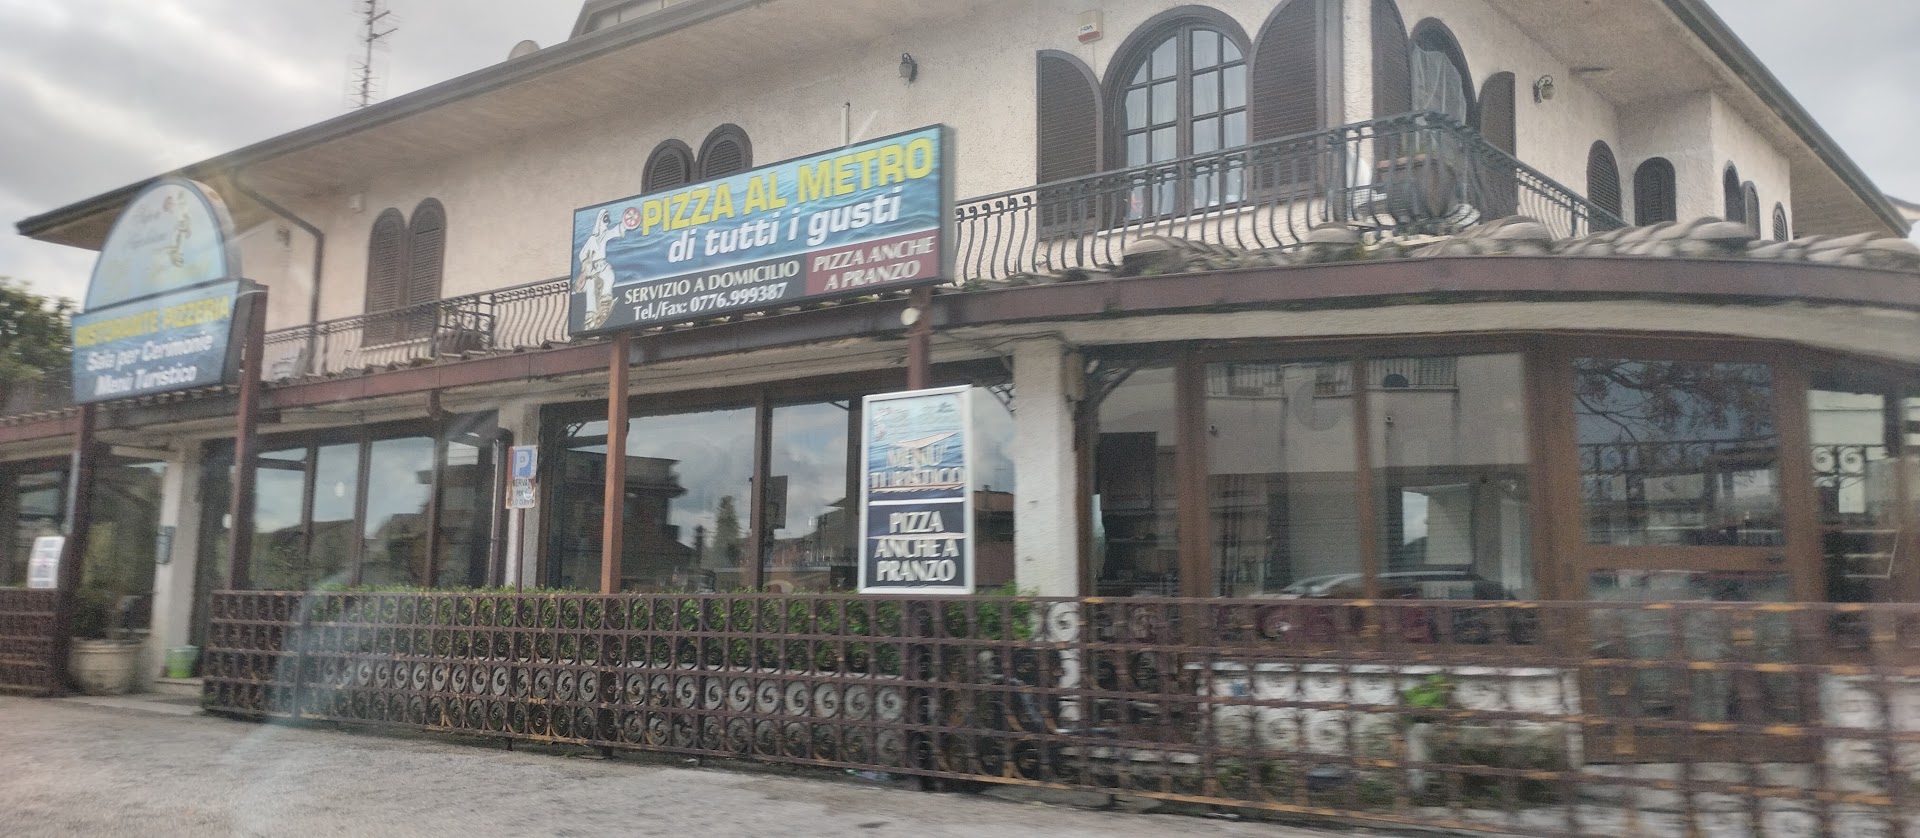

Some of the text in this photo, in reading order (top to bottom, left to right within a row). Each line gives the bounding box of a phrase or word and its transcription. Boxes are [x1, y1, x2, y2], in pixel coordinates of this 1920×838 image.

[642, 138, 933, 235] PIZZA AL METRO
[667, 186, 904, 263] di tutti i gusti
[812, 235, 936, 273] PIZZA ANCHE
[624, 260, 801, 305] SERVIZIO A DOMICILIO
[824, 260, 921, 291] A PRANZO
[162, 296, 230, 330] PIZZERIA
[633, 282, 788, 321] Tel./Fax: 0776.999387
[115, 348, 141, 372] per
[134, 361, 198, 390] Turistico
[515, 451, 530, 477] P
[889, 511, 944, 534] PIZZA
[874, 539, 960, 558] ANCHE A
[876, 559, 957, 582] PRANZO
